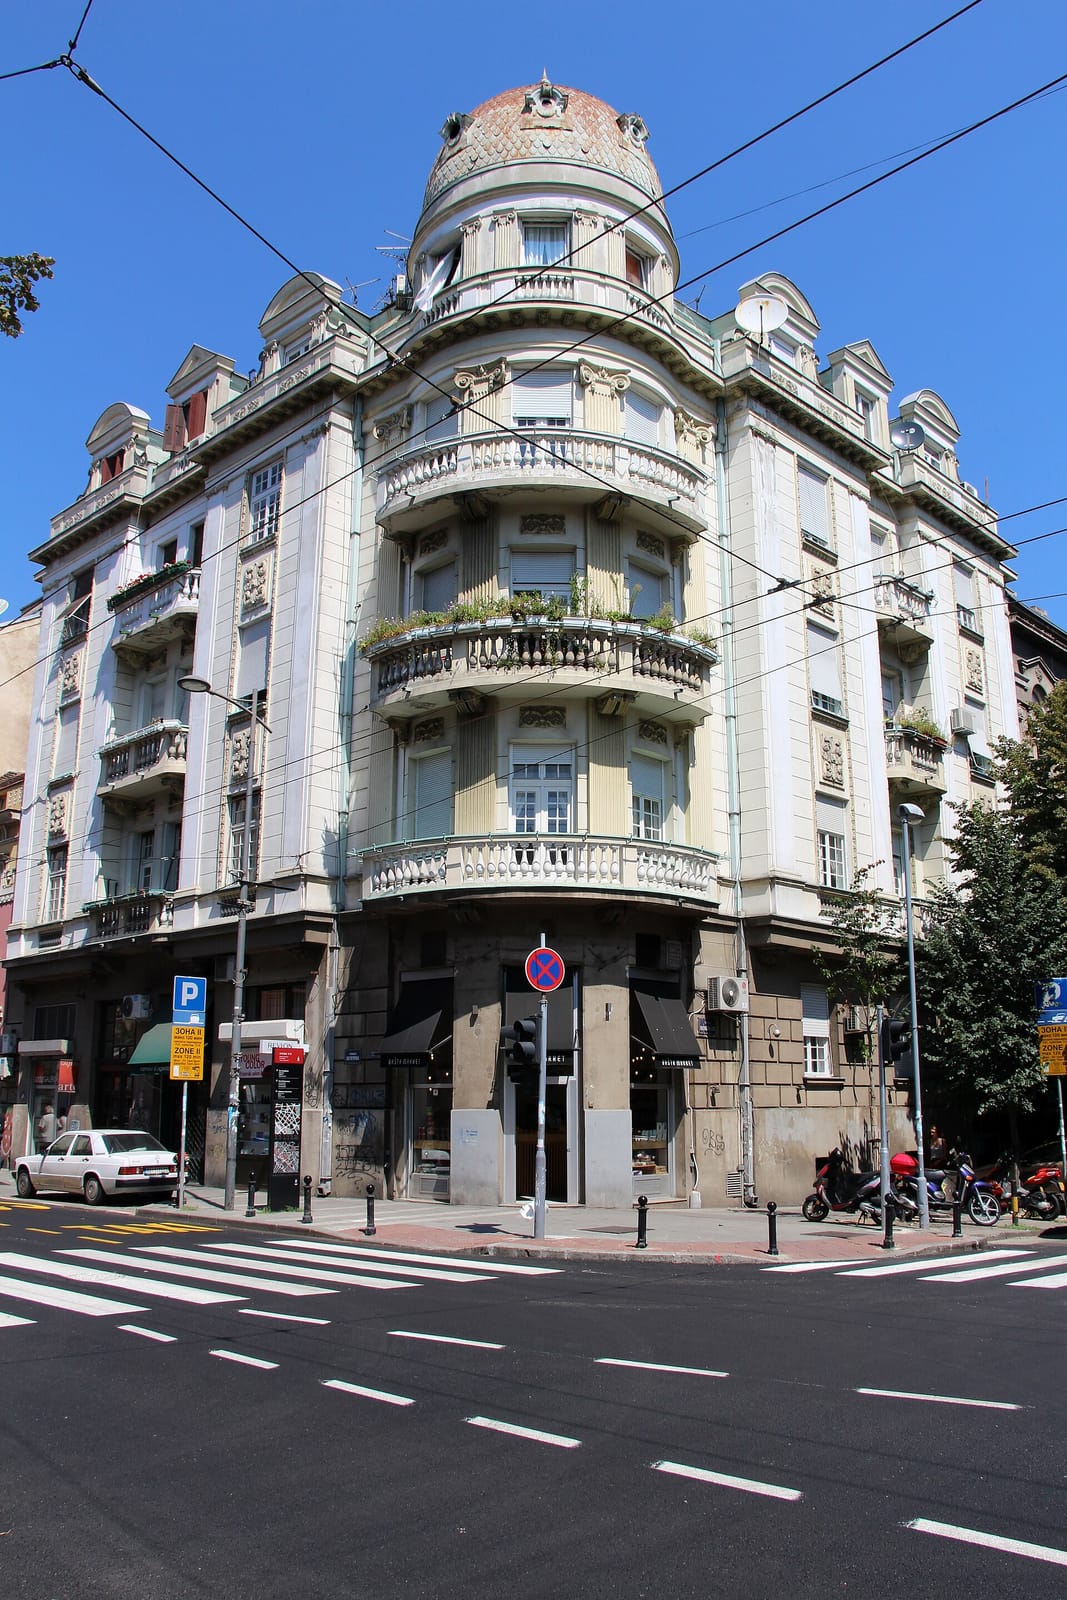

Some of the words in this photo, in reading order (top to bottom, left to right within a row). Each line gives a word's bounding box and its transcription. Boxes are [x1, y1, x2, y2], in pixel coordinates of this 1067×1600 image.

[181, 981, 198, 1006] P
[175, 1027, 196, 1035] ЗОНА
[174, 1047, 194, 1055] ZONE
